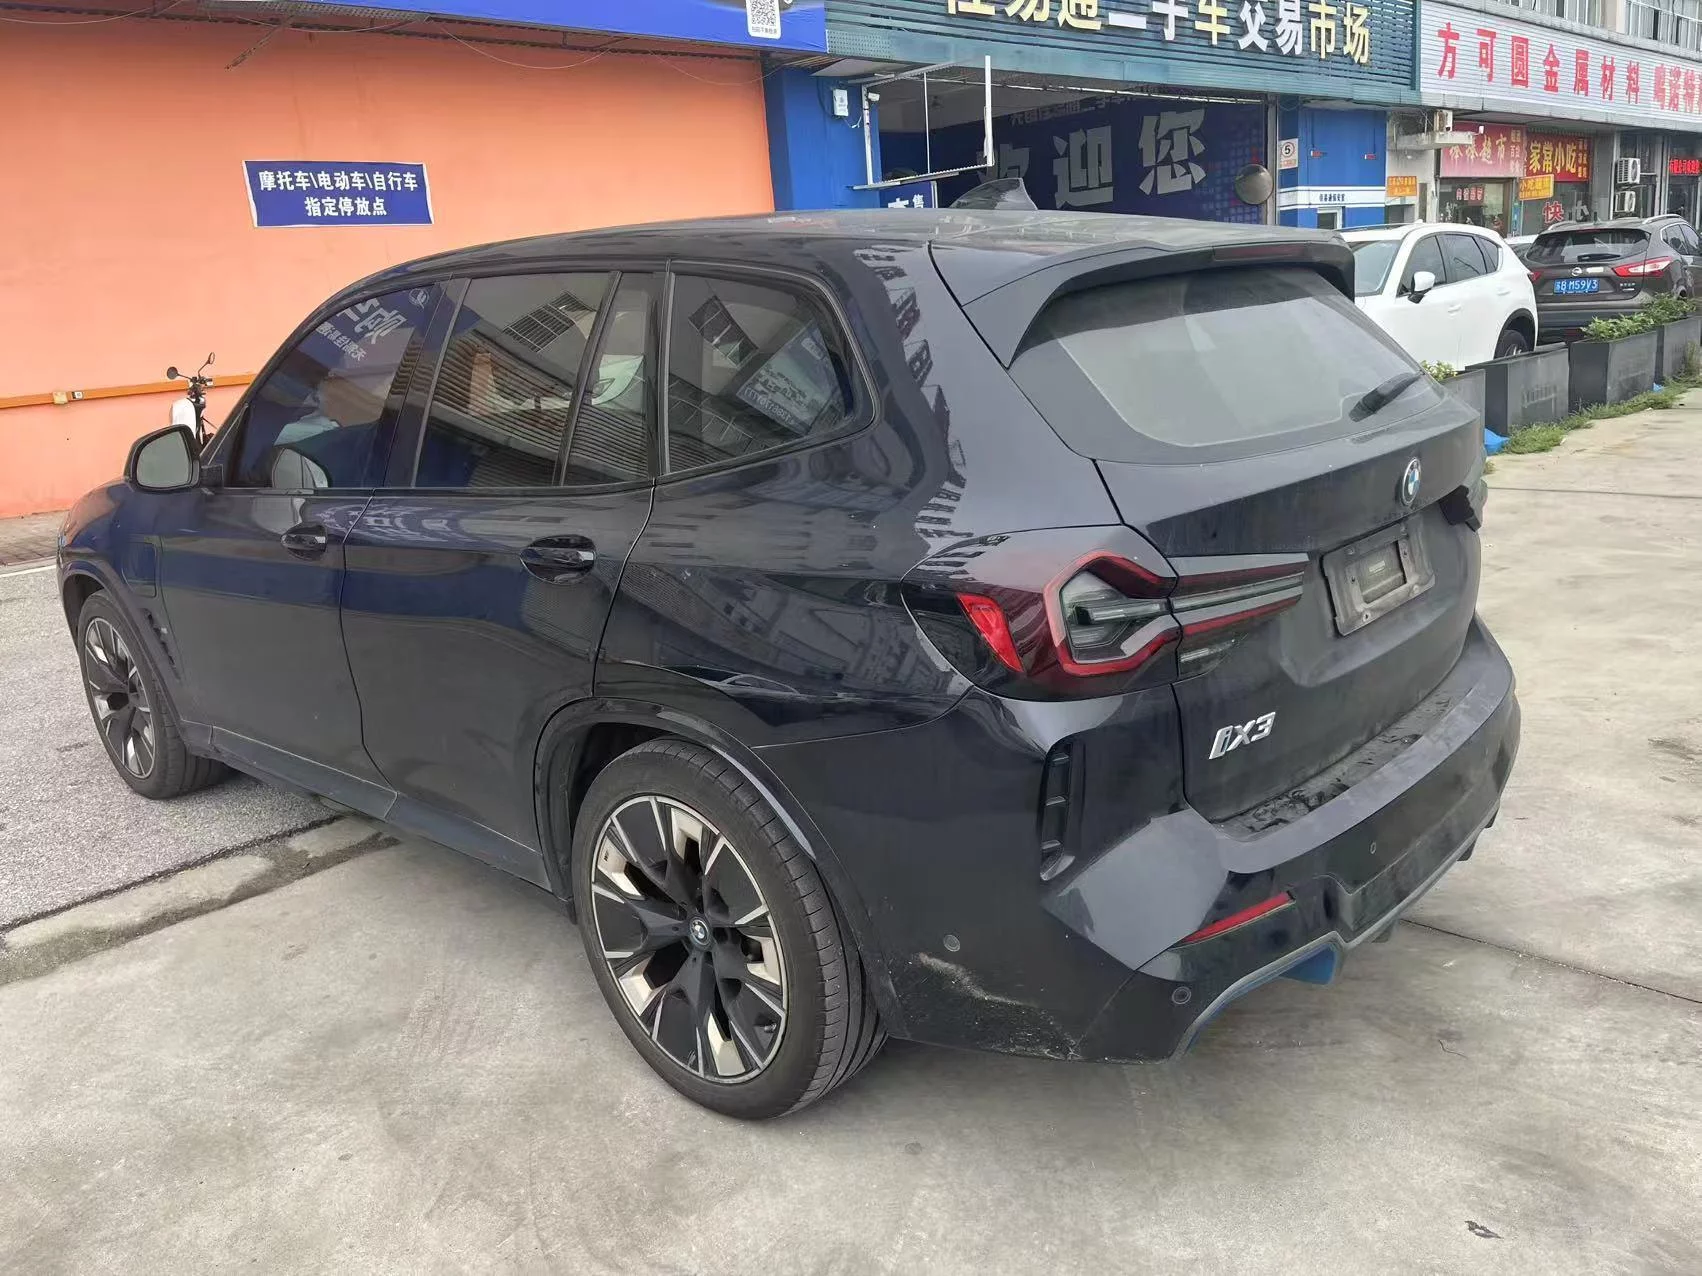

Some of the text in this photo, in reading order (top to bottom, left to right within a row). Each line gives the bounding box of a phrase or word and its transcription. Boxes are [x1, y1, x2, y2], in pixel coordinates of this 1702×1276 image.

[948, 0, 1369, 63] 手车交易市场
[1437, 22, 1640, 104] 方可圆金属材料
[1529, 140, 1577, 173] 家常小吃
[258, 170, 418, 191] 摩托车\电动车\自行车
[304, 196, 387, 216] 指定停放点
[1209, 712, 1276, 760] iX3
